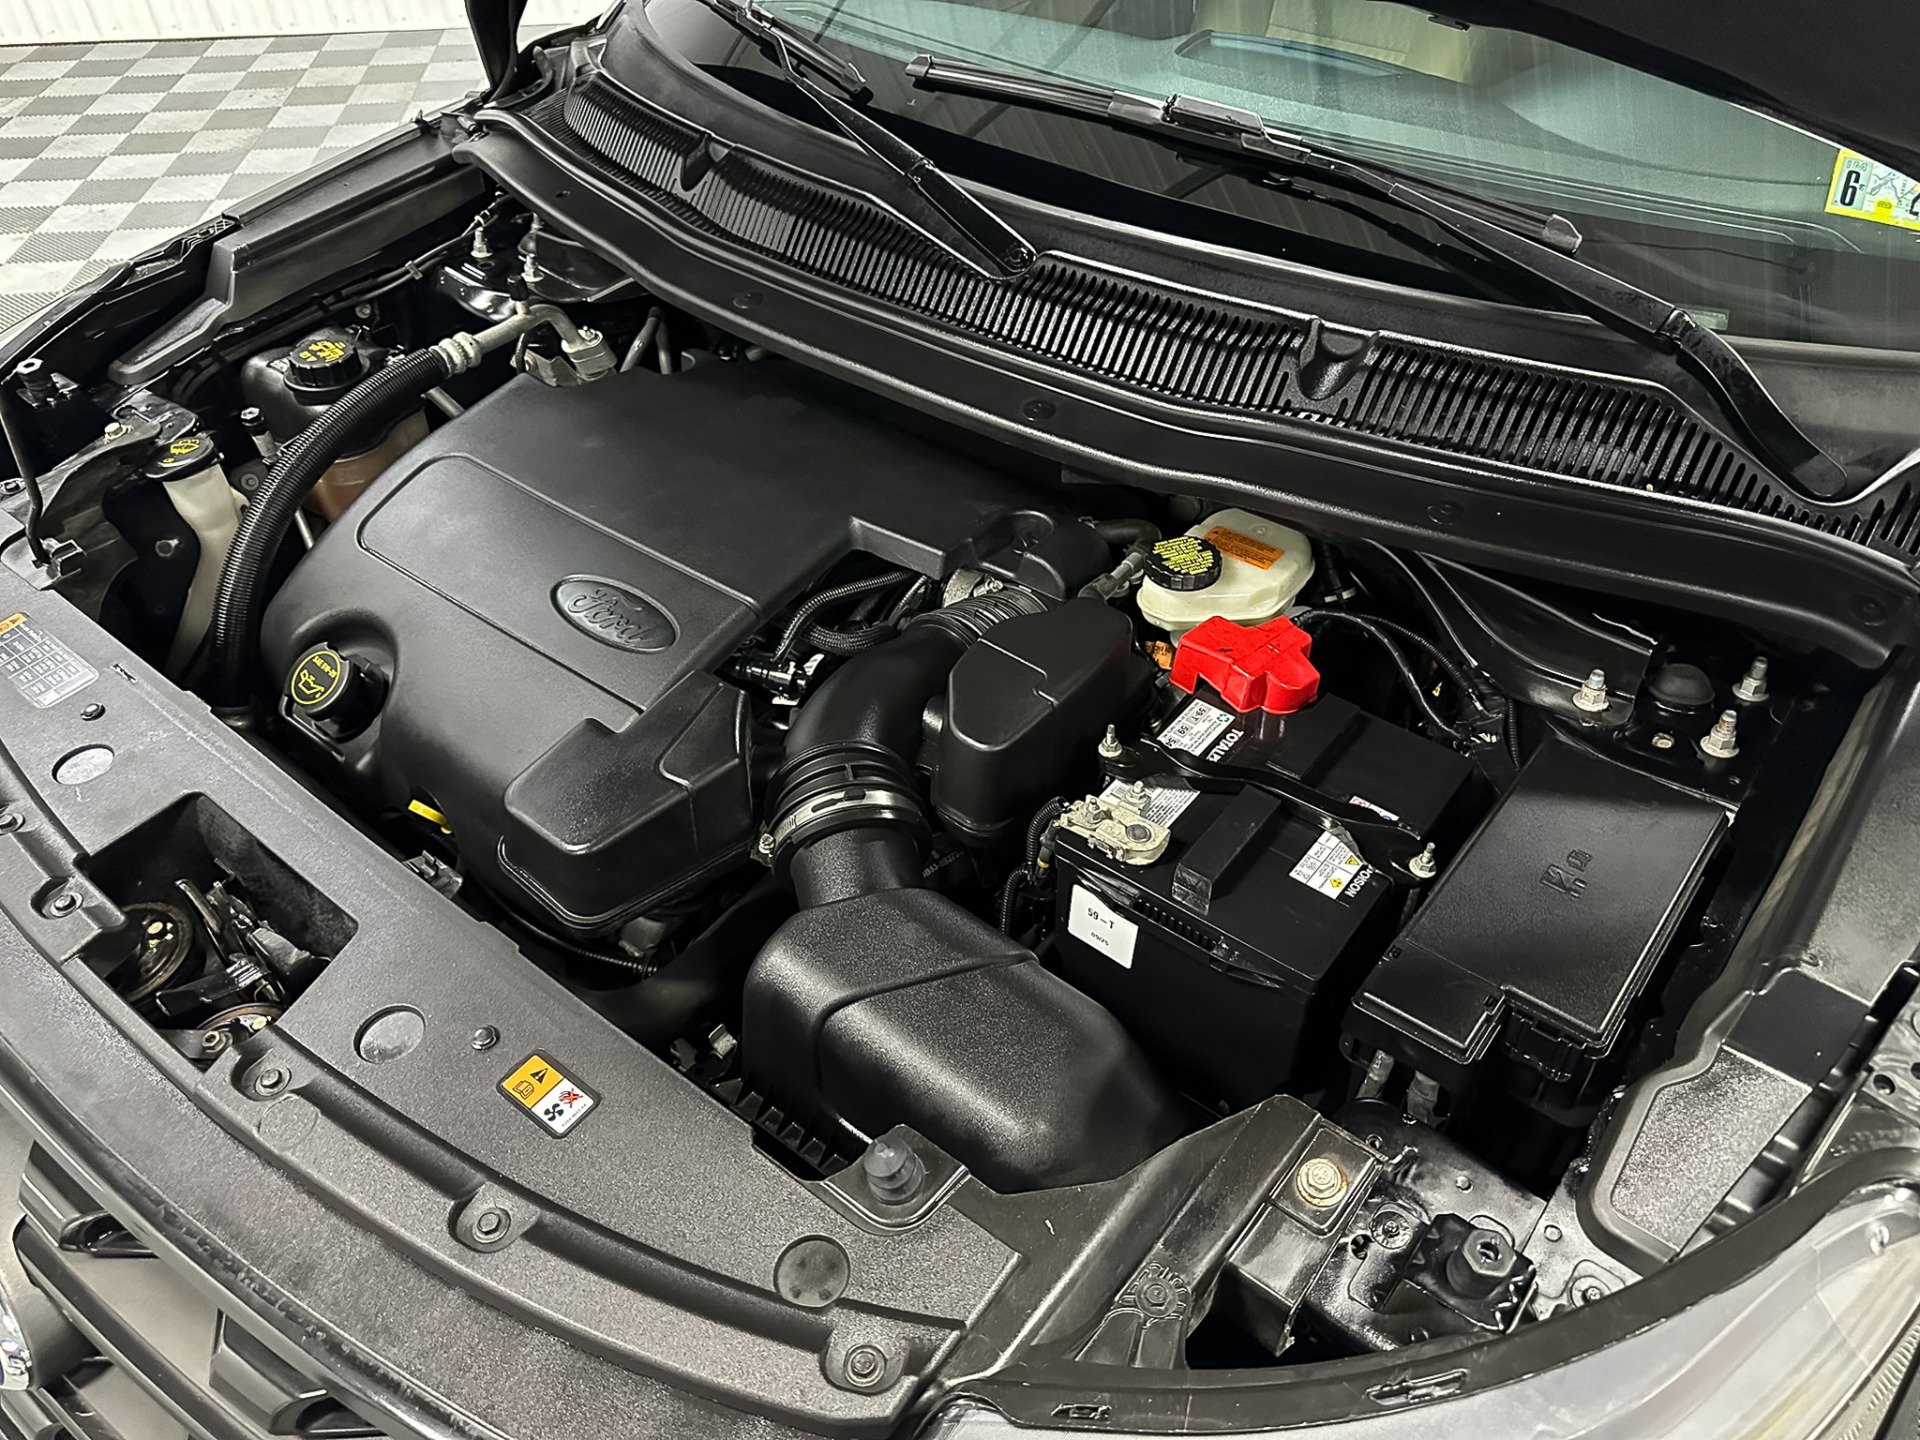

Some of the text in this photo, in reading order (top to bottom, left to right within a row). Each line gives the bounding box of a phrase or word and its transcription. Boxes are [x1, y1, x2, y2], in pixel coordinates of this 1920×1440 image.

[1840, 170, 1861, 206] 6
[567, 586, 656, 646] Ford
[1087, 907, 1115, 930] 59-T
